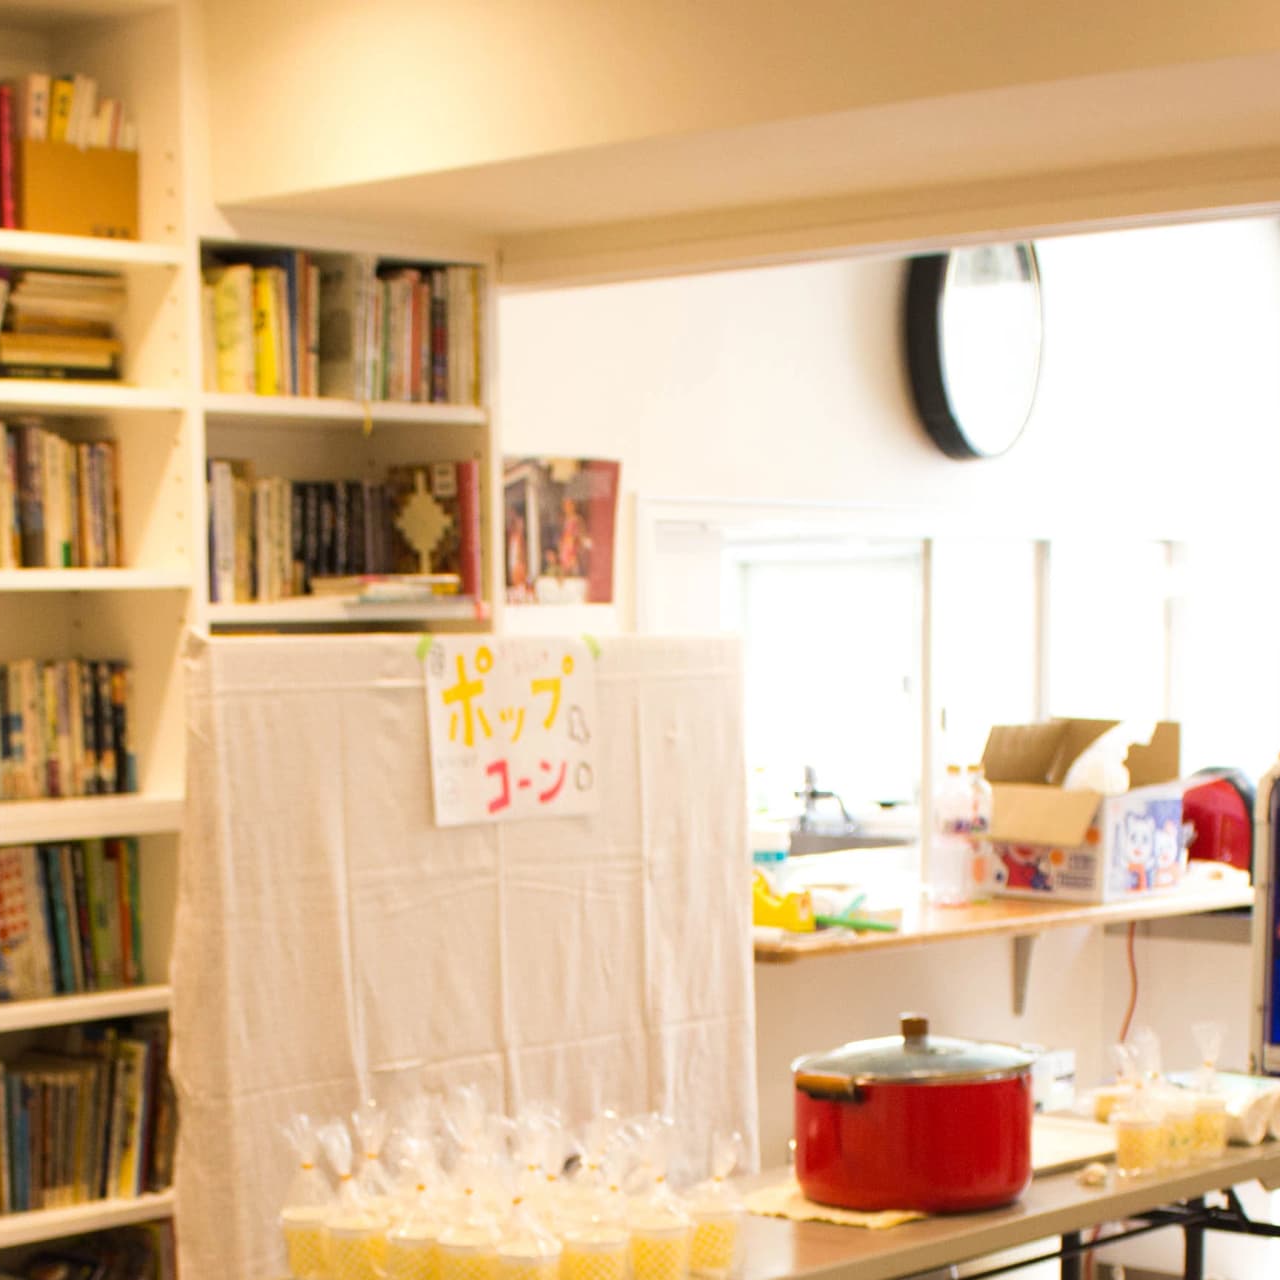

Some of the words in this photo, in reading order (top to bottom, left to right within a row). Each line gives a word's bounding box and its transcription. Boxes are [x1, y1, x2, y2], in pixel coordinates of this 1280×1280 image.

[441, 645, 575, 747] ポップ
[485, 759, 568, 814] コーン
